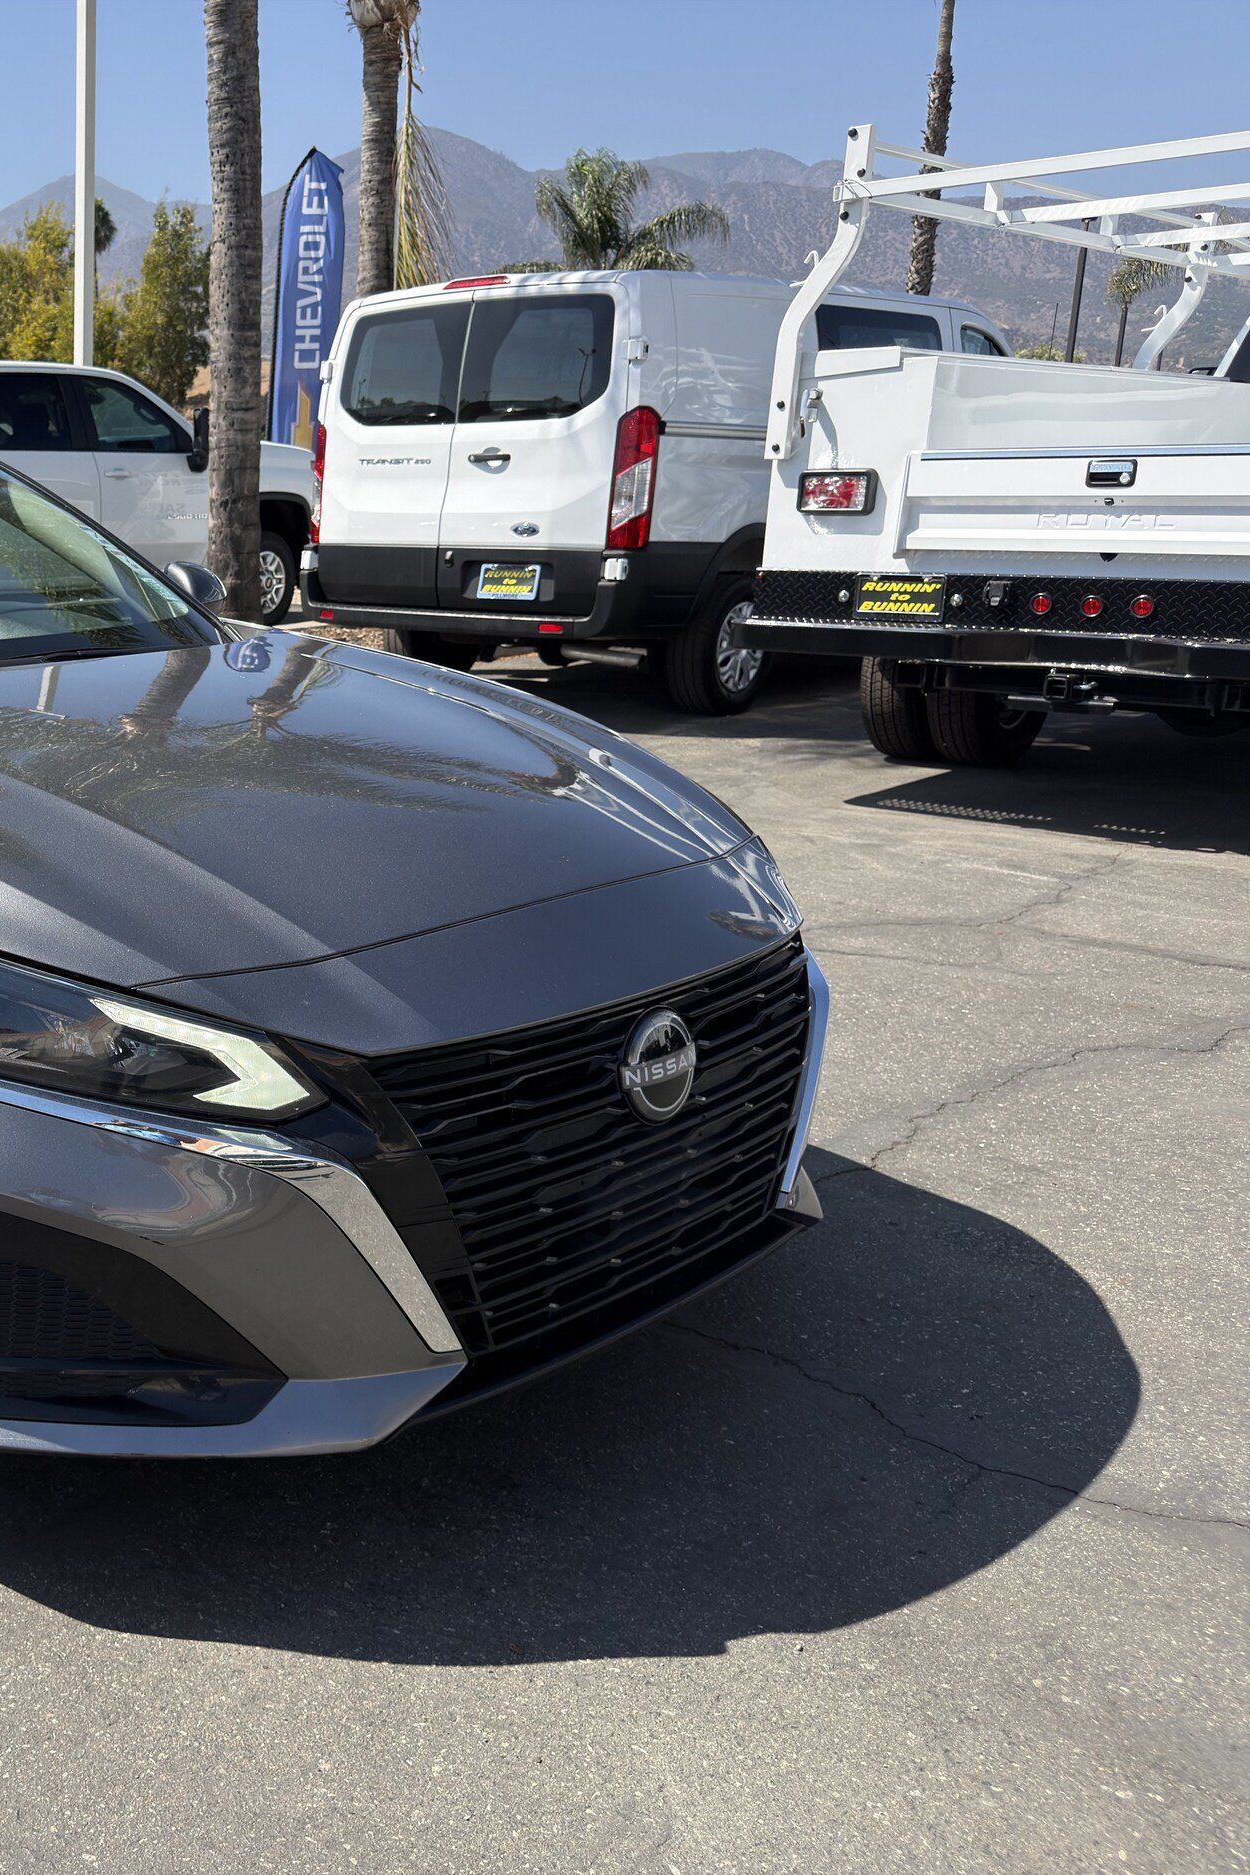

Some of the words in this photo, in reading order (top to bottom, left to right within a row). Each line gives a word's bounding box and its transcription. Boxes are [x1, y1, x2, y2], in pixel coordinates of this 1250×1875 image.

[293, 173, 329, 370] CHEVROLET
[1037, 514, 1175, 530] ROYAL
[481, 584, 533, 593] BUNNIN
[861, 581, 941, 593] RUNNIN'
[890, 592, 911, 601] to
[859, 601, 935, 612] BUNNIN
[625, 1044, 696, 1086] NISSAN
